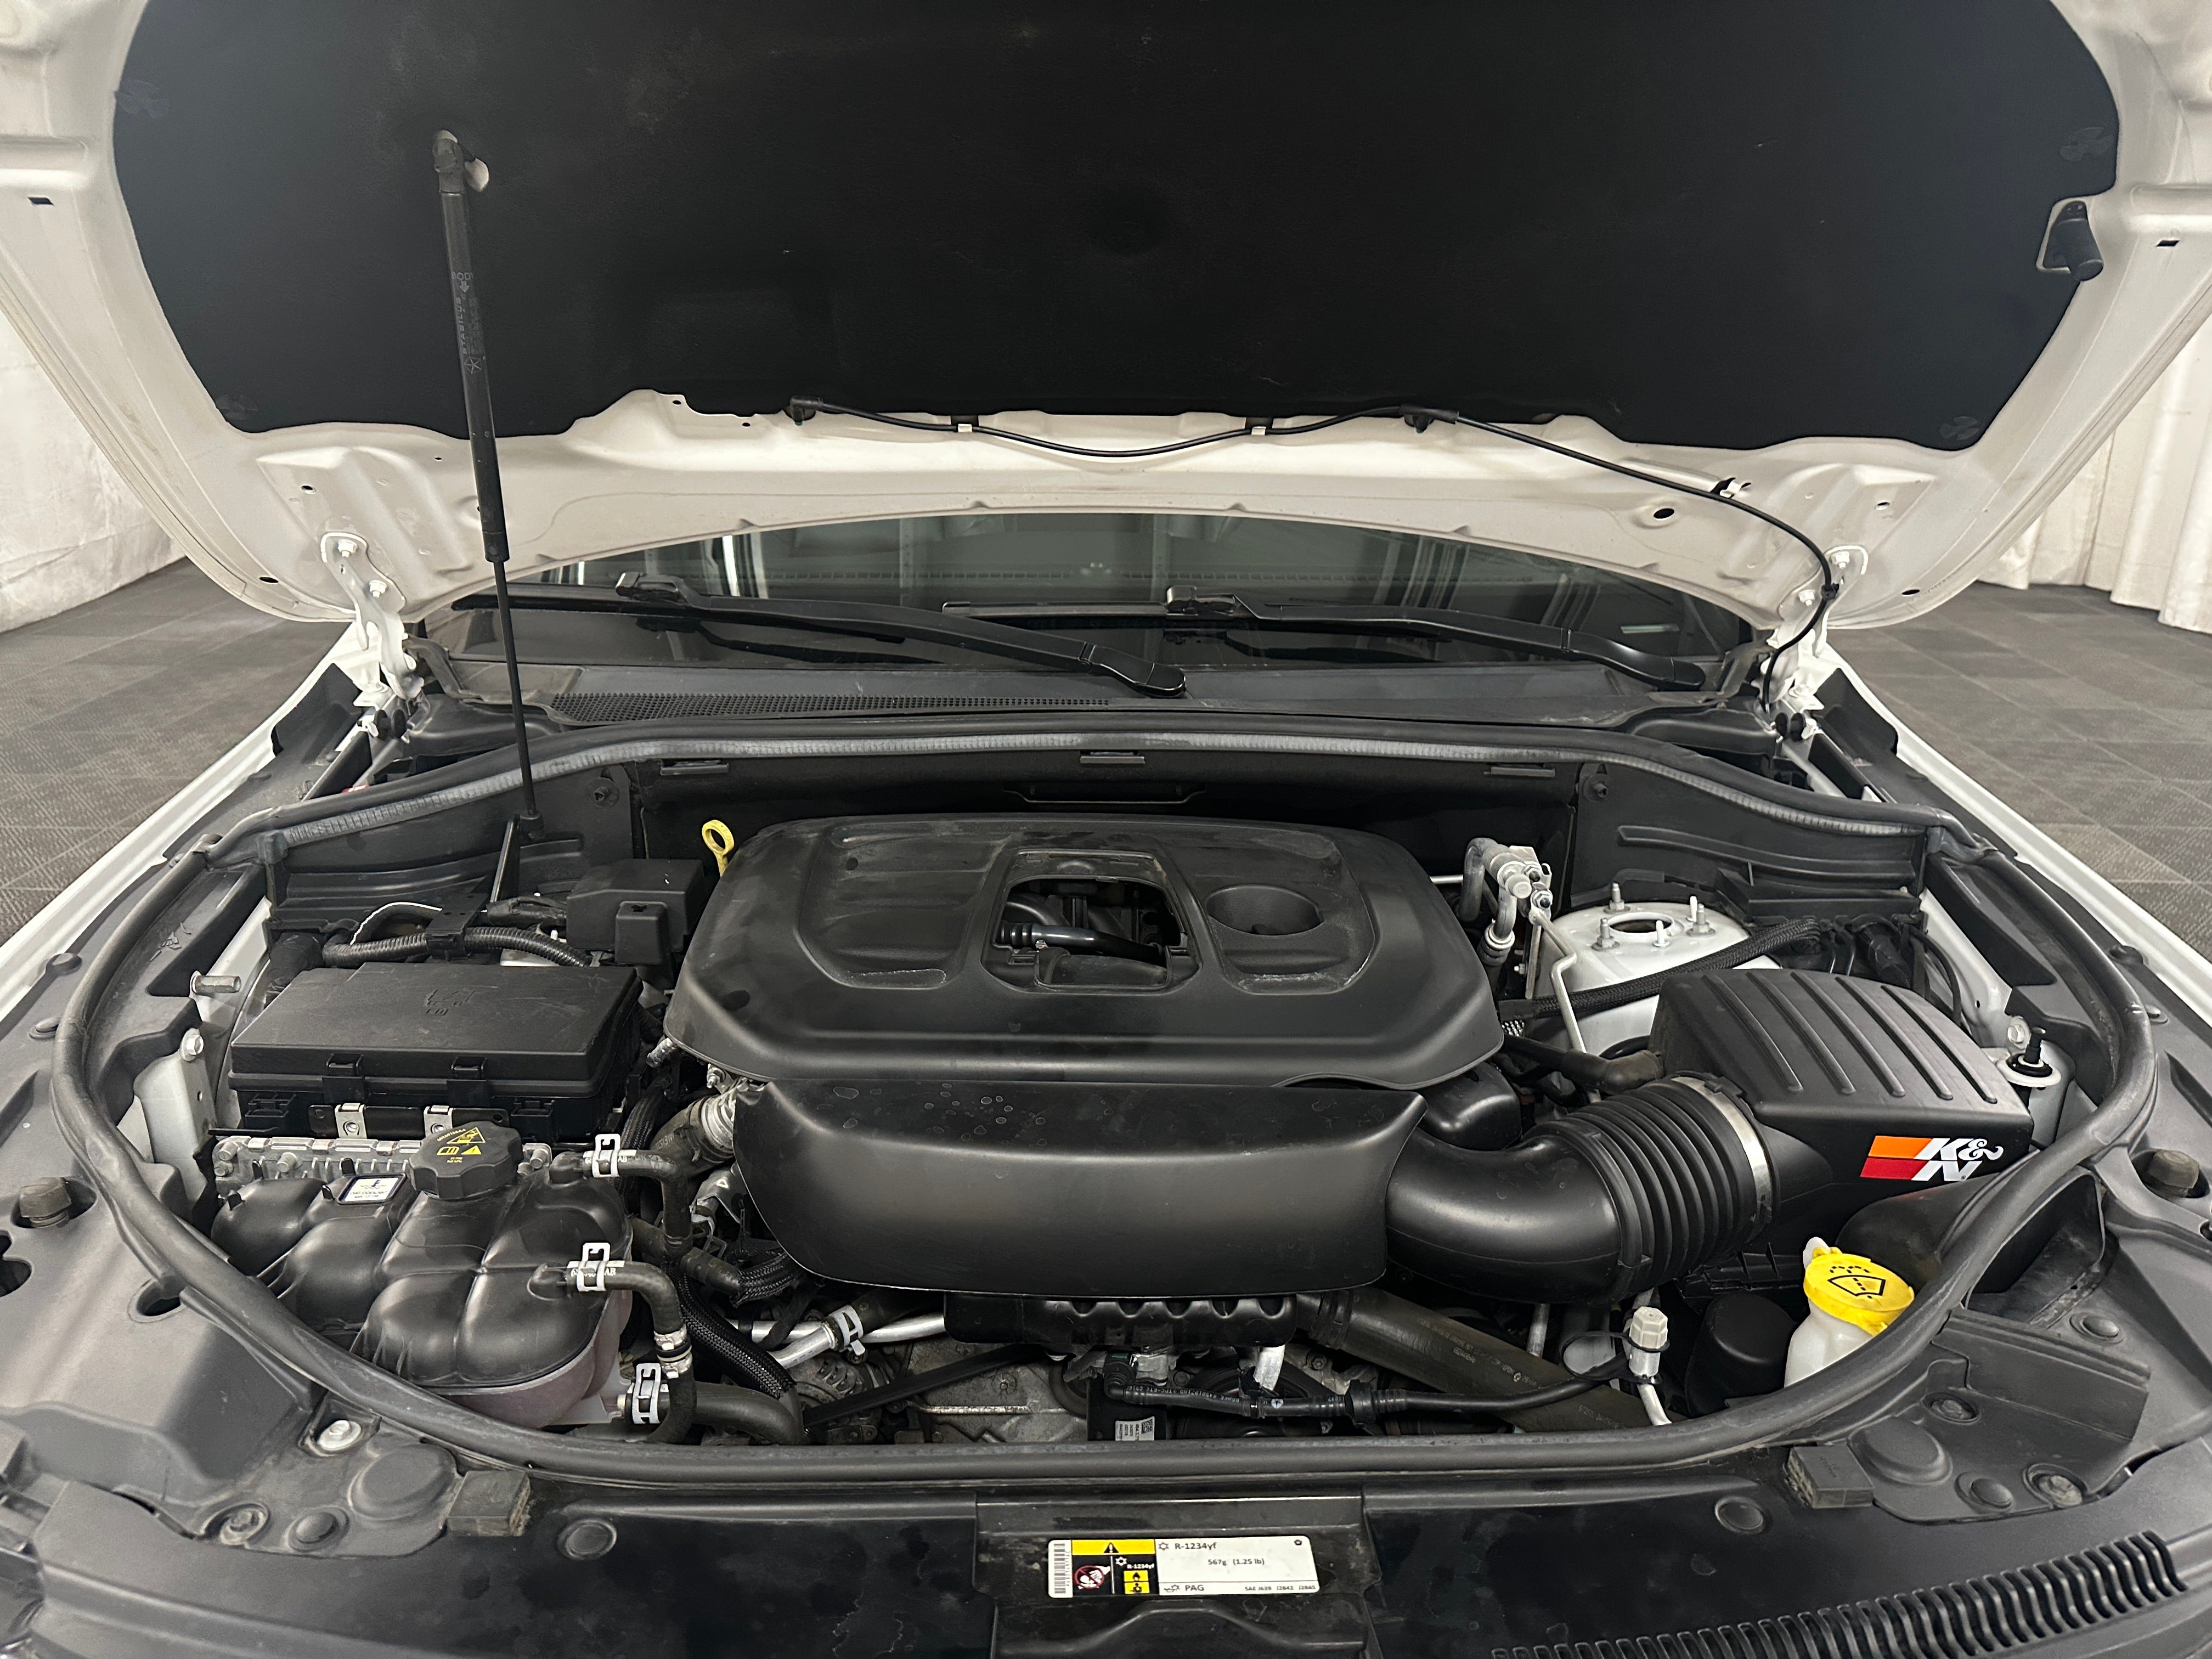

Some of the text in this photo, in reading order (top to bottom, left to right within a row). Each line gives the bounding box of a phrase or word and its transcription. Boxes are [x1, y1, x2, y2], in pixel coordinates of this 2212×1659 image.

[451, 272, 474, 280] BODY
[455, 296, 468, 354] STABILUS
[1175, 1542, 1217, 1550] R-1234yf
